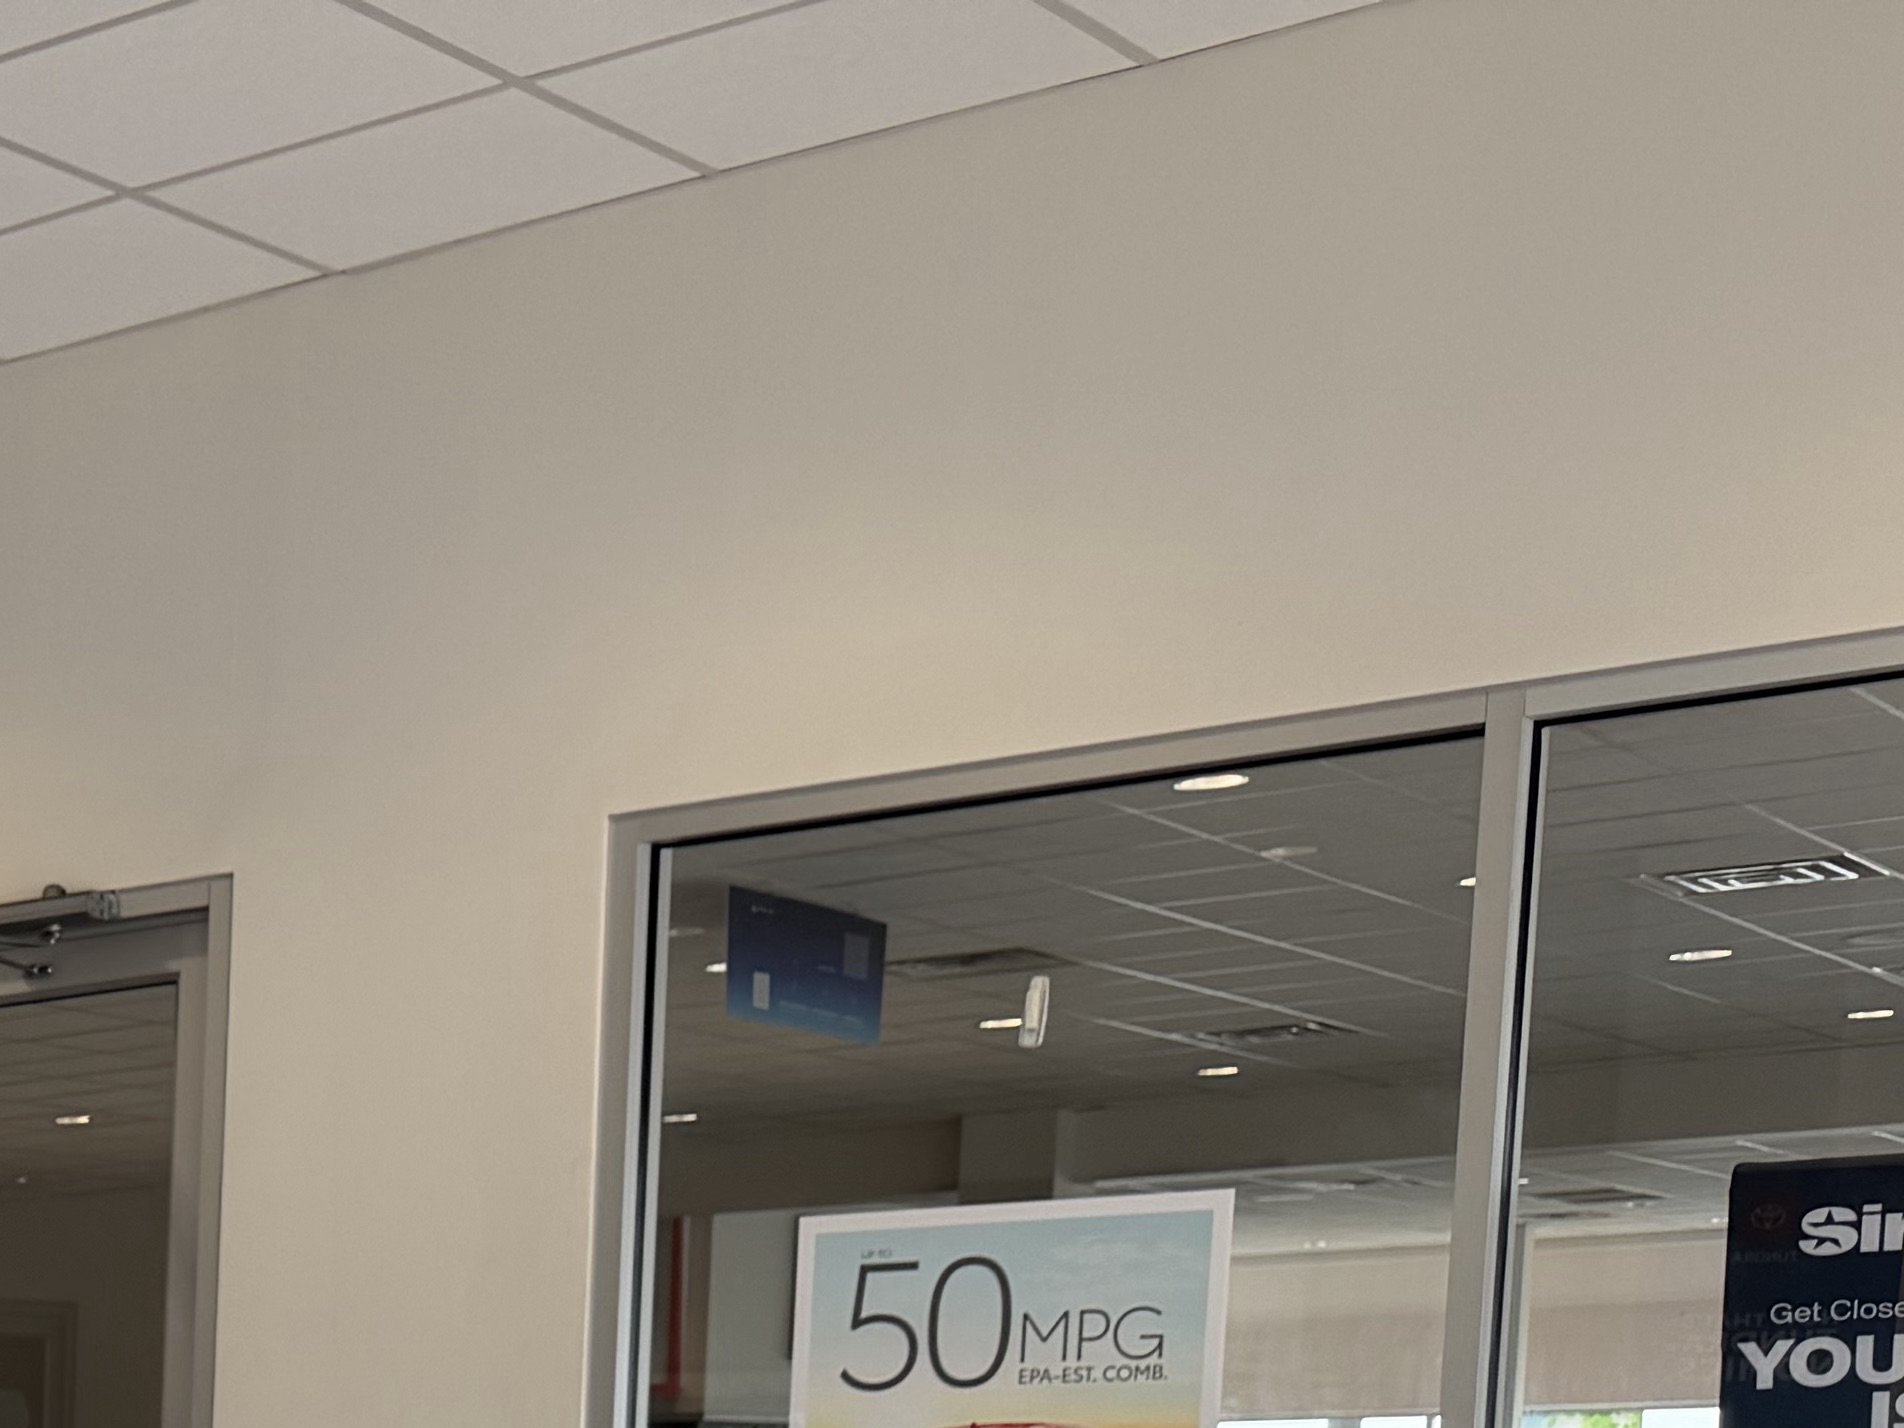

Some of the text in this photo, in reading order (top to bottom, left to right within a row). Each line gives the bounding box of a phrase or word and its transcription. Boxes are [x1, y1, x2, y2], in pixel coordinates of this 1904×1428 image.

[839, 1256, 1012, 1392] 50
[1770, 1302, 1822, 1325] Get
[1020, 1306, 1165, 1363] MPG
[1018, 1364, 1168, 1385] EPA-EST. COMB.
